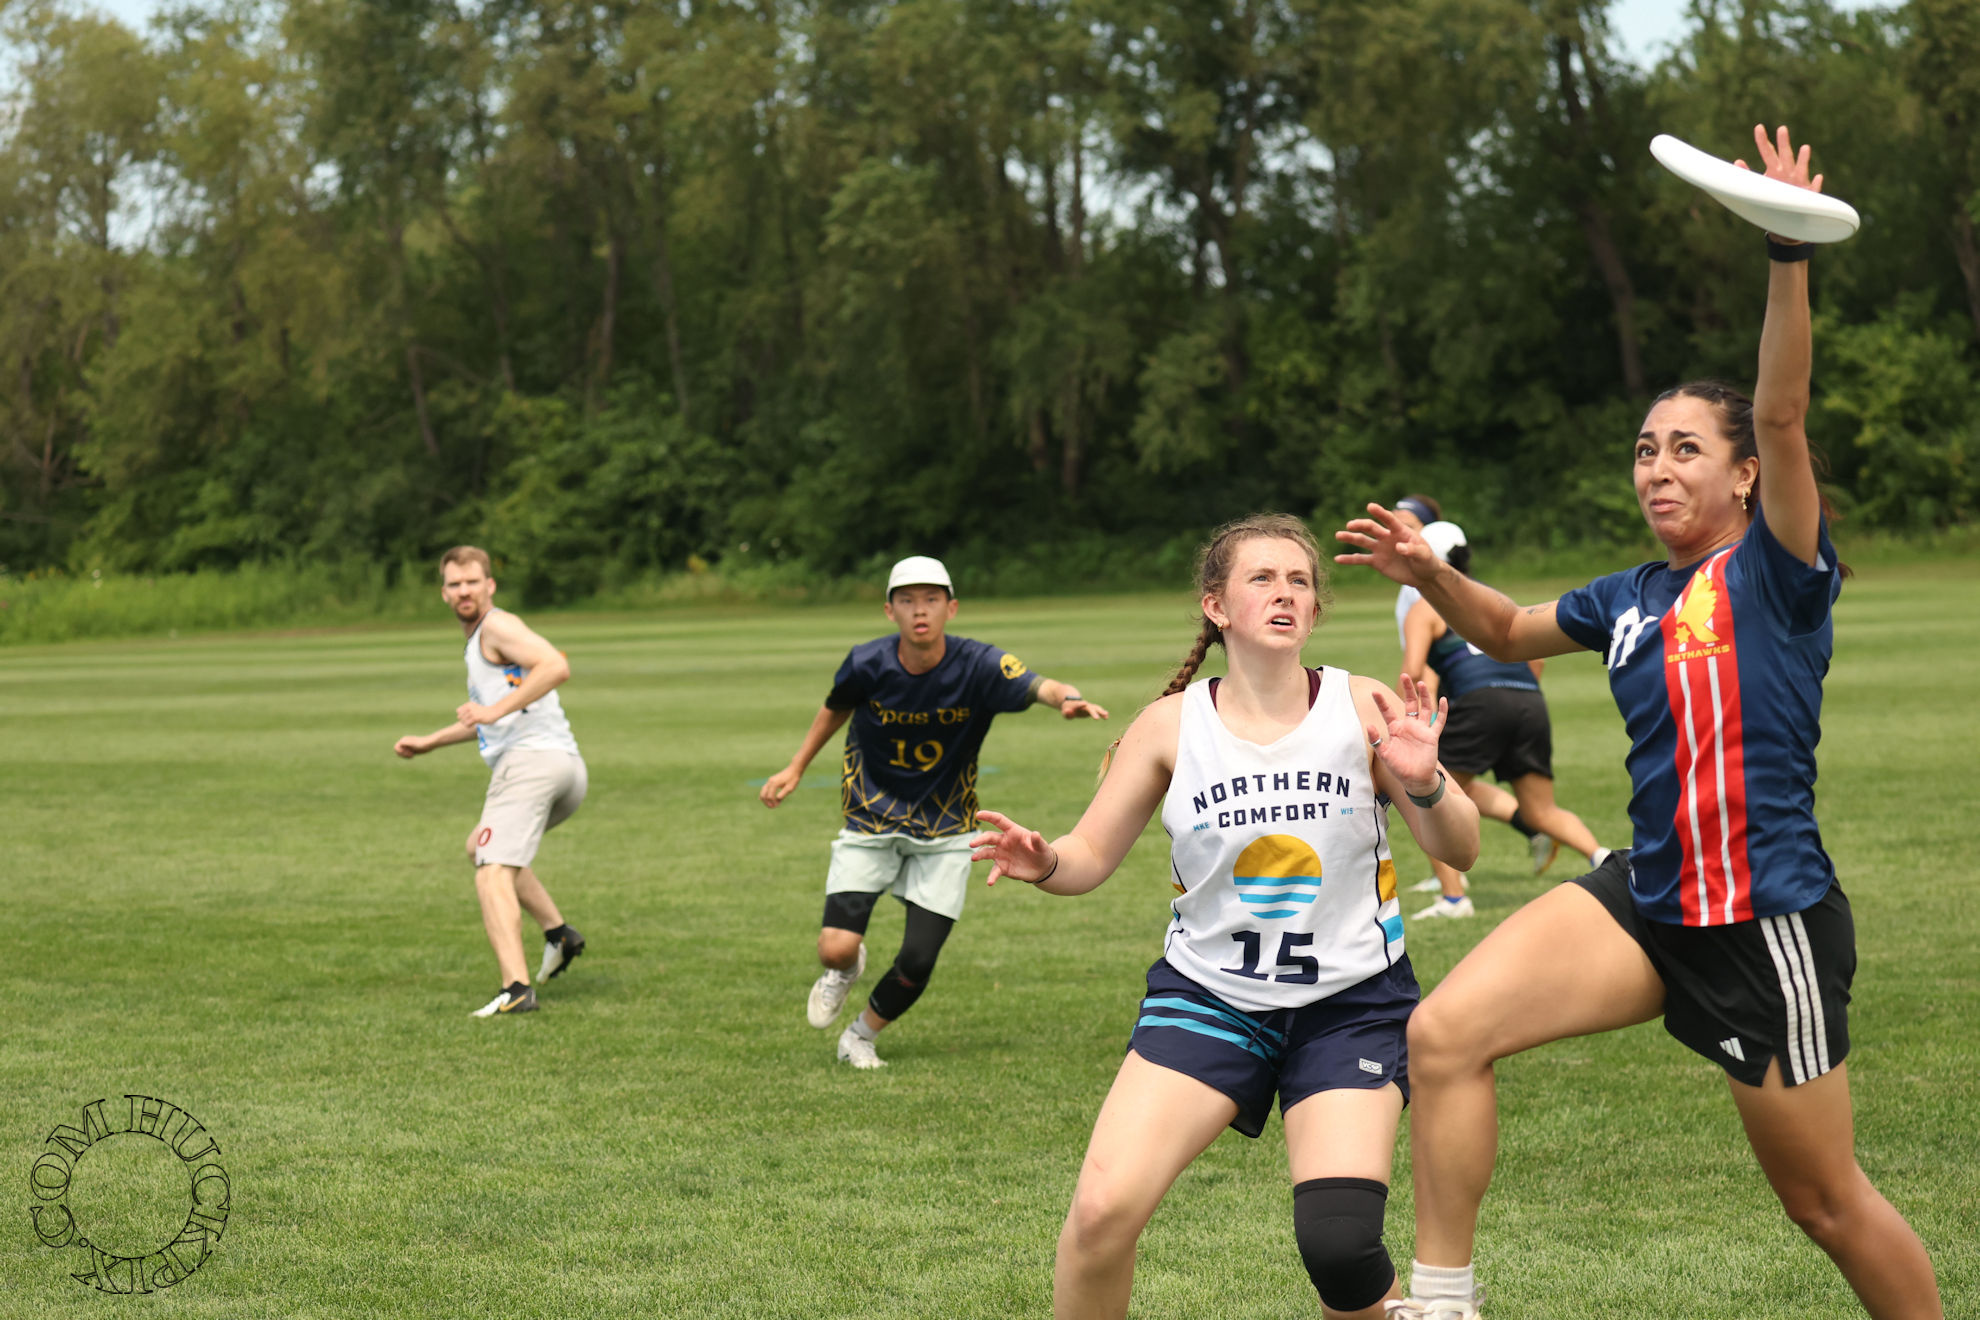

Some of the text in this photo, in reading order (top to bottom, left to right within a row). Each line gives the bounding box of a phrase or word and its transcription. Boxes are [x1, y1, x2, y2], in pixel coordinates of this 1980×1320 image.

[1667, 644, 1731, 663] SKYHAWKS
[889, 738, 944, 772] 19
[1193, 771, 1350, 814] NORTHERN
[1218, 802, 1329, 828] COMFORT
[1220, 930, 1319, 985] 15
